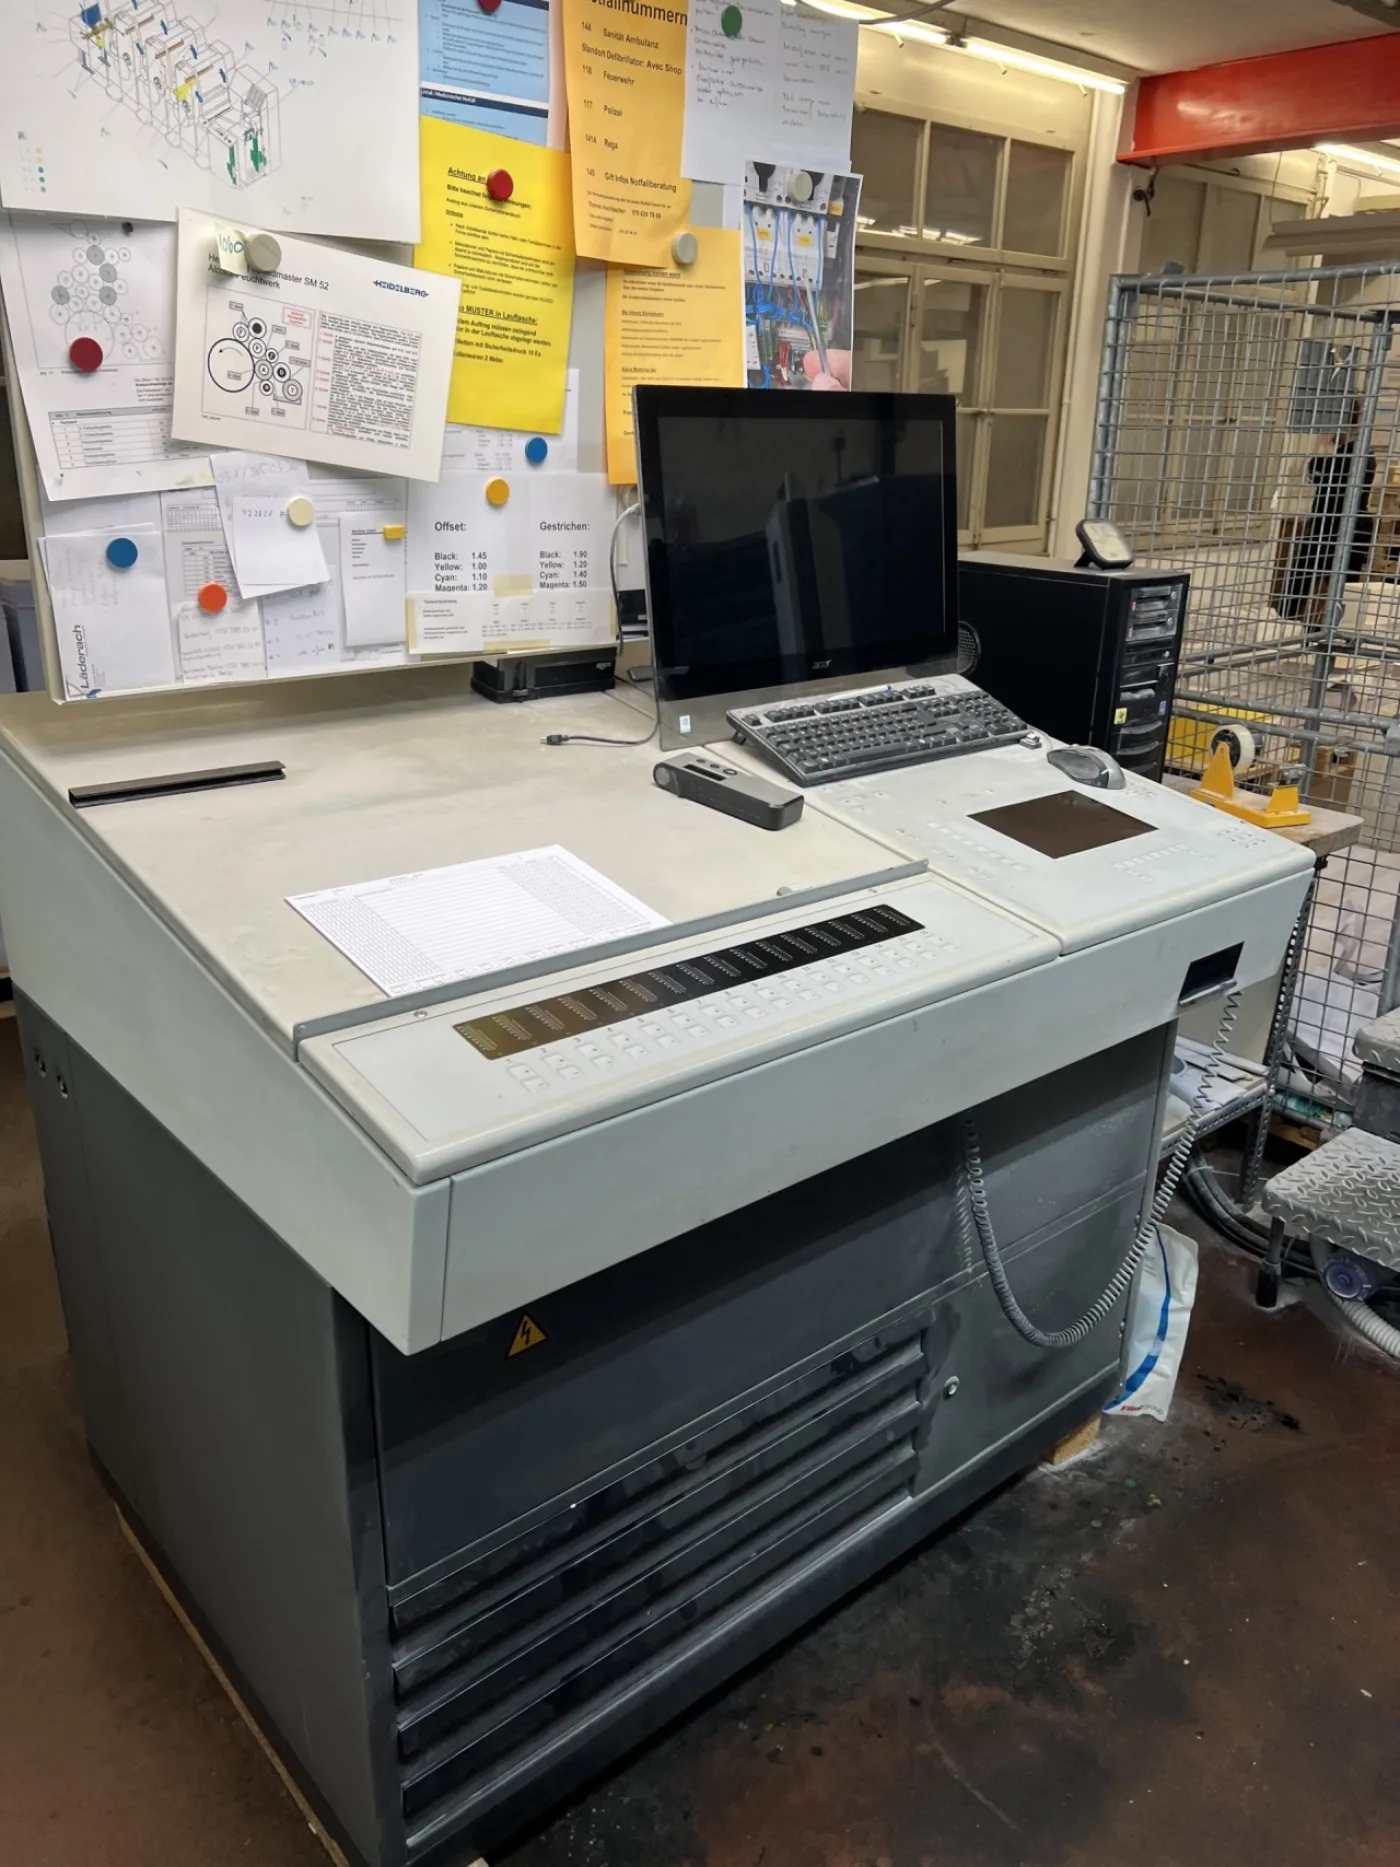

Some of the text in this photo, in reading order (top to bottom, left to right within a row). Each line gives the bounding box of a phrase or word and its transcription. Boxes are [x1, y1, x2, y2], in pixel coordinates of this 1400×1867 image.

[581, 21, 660, 50] 144 Sanität Ambulanz
[581, 43, 683, 76] Standort Defibrillator: Avec Shop
[603, 70, 635, 87] Feuerwehr
[603, 105, 623, 117] Polizei
[603, 138, 618, 151] Rega
[447, 167, 477, 182] Achtung
[604, 172, 615, 182] Gift
[630, 177, 677, 194] Notfallberatung
[304, 277, 318, 288] SM
[319, 280, 330, 291] 52
[373, 279, 429, 299] HEIDELBERG
[465, 304, 494, 317] MUSTER
[502, 312, 539, 326] Lauftasche:
[470, 320, 491, 330] Auftrag
[481, 329, 510, 341] Lauftasche
[434, 521, 467, 532] Offset:
[539, 521, 591, 531] Gestrichen:
[434, 551, 488, 561] Black: 1.45
[539, 550, 588, 559] Black: 1.90
[434, 562, 488, 571] Yellow: 1.00
[539, 560, 588, 569] Yellow: 1.20
[434, 572, 488, 583] Cyan: 1.10
[539, 570, 588, 581] Cyan: 1.40
[434, 583, 488, 592] Magenta: 1.20
[539, 580, 587, 590] Magenta: 1.50
[72, 624, 90, 689] Läderach
